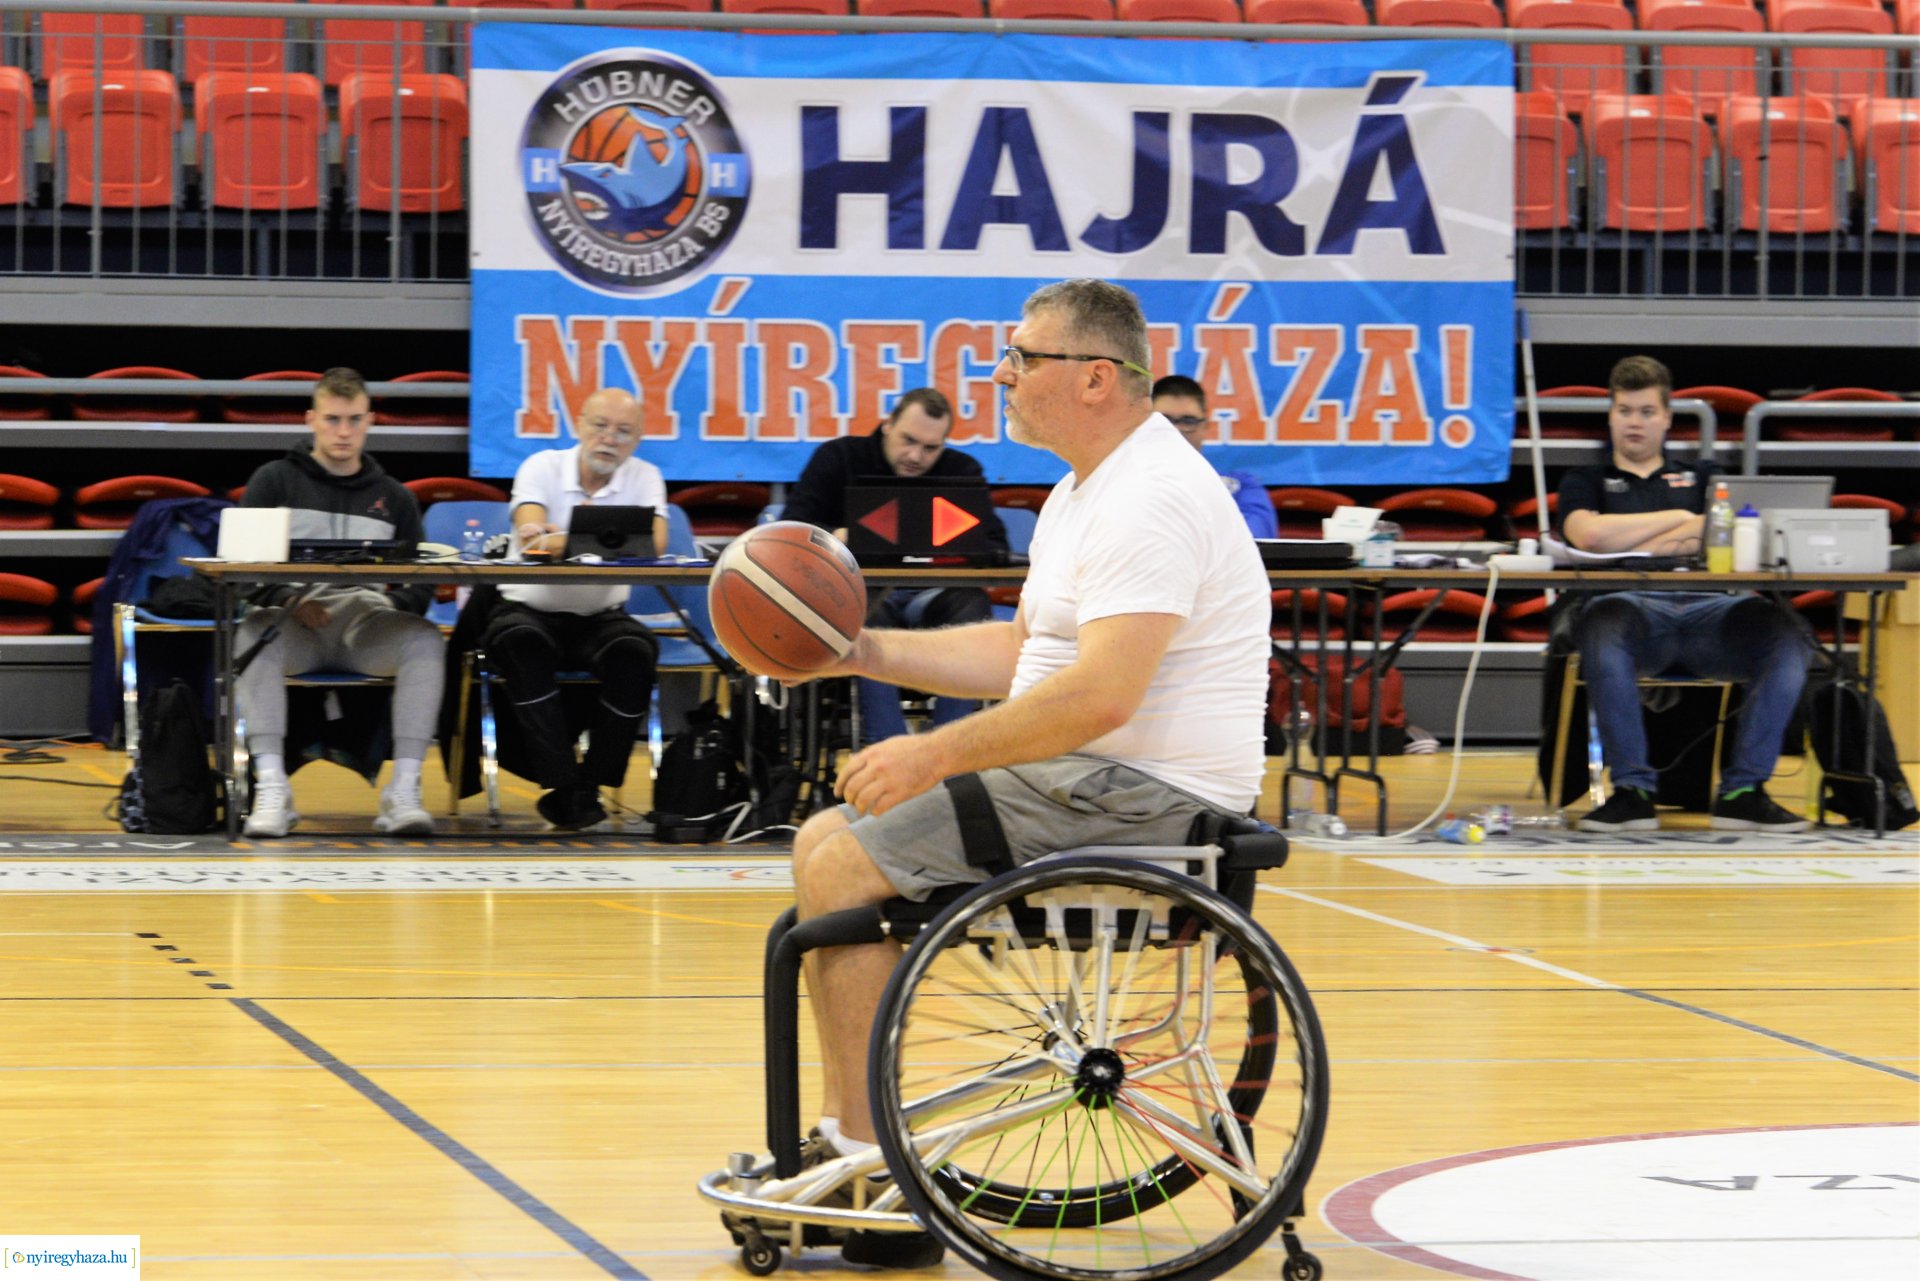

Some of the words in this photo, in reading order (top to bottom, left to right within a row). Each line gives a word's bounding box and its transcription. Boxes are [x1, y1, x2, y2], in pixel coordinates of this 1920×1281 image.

[531, 157, 556, 184] H
[711, 162, 737, 188] H
[800, 75, 1447, 257] HAJRÁ
[695, 202, 730, 238] BS
[517, 279, 1475, 447] NYÍREGÁZA!
